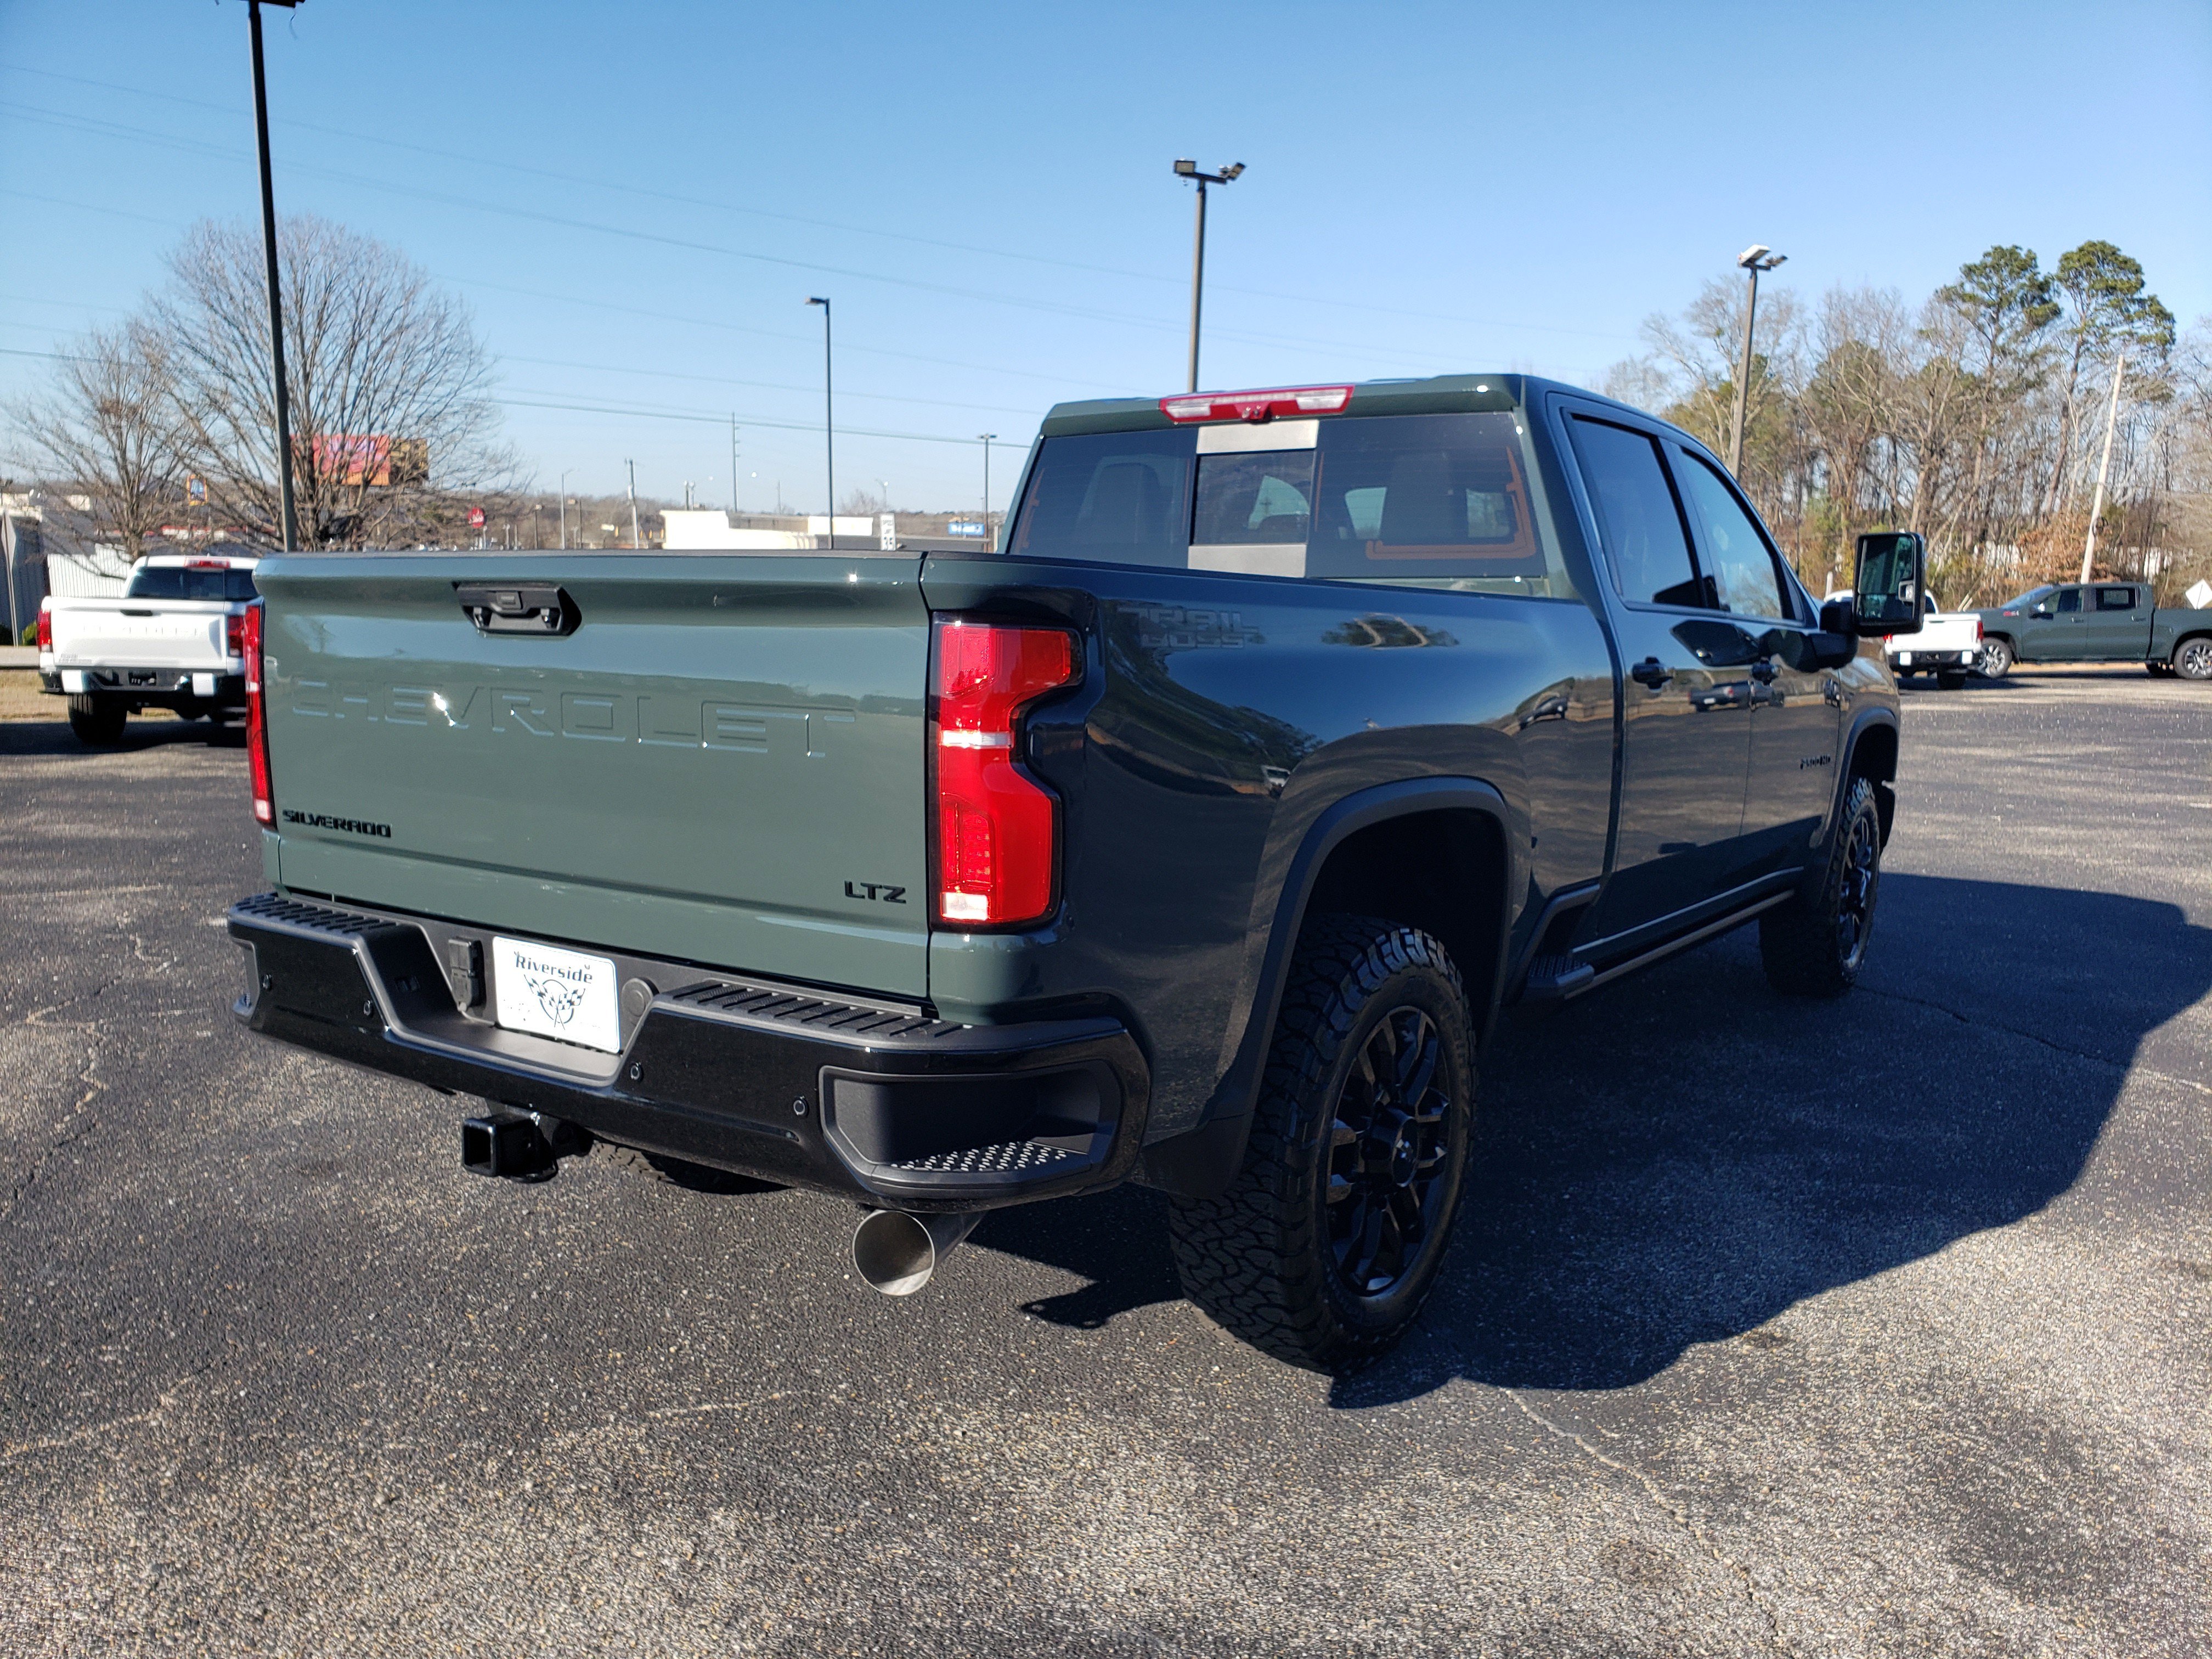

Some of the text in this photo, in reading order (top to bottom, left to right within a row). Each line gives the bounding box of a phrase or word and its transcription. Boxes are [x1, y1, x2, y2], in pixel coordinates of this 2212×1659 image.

[292, 676, 856, 758] CHEVROLET
[282, 809, 392, 838] SILVERADO
[844, 880, 907, 905] LTZ
[515, 955, 593, 984] Riverside
